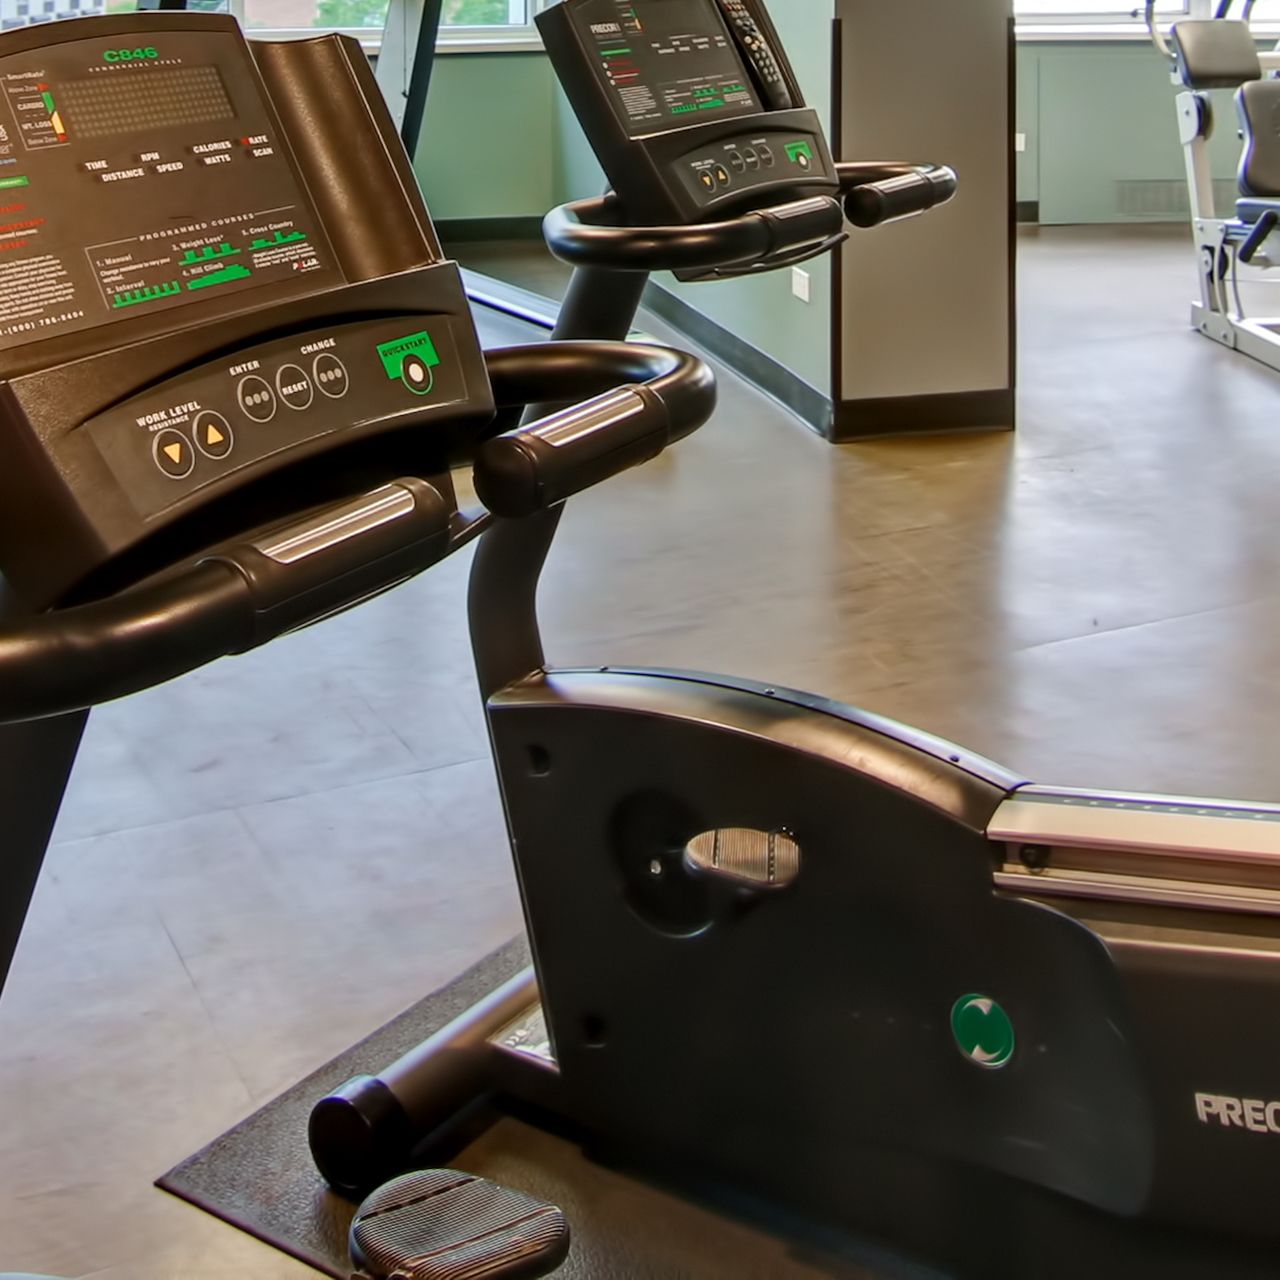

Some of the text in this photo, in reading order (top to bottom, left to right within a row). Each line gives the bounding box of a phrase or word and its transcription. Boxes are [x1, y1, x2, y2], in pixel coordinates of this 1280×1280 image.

[103, 47, 158, 62] C846
[248, 135, 268, 145] RATE
[193, 141, 232, 154] CALORIES
[253, 147, 273, 157] SCAN
[141, 152, 160, 162] RPM
[204, 154, 231, 165] WATTS
[85, 160, 108, 170] TIME
[156, 162, 183, 173] SPEED
[102, 168, 145, 182] DISTANCE
[139, 213, 254, 242] PROGRAMMED COURSES
[180, 239, 205, 251] Weight
[104, 253, 133, 266] Manual
[115, 280, 145, 293] Interval
[300, 337, 336, 355] CHANGE
[382, 337, 427, 357] QUICKSTART
[229, 360, 260, 376] ENTER
[282, 380, 308, 396] RESET
[136, 400, 201, 427] WORK LEVEL
[148, 414, 190, 432] RESISTANCE
